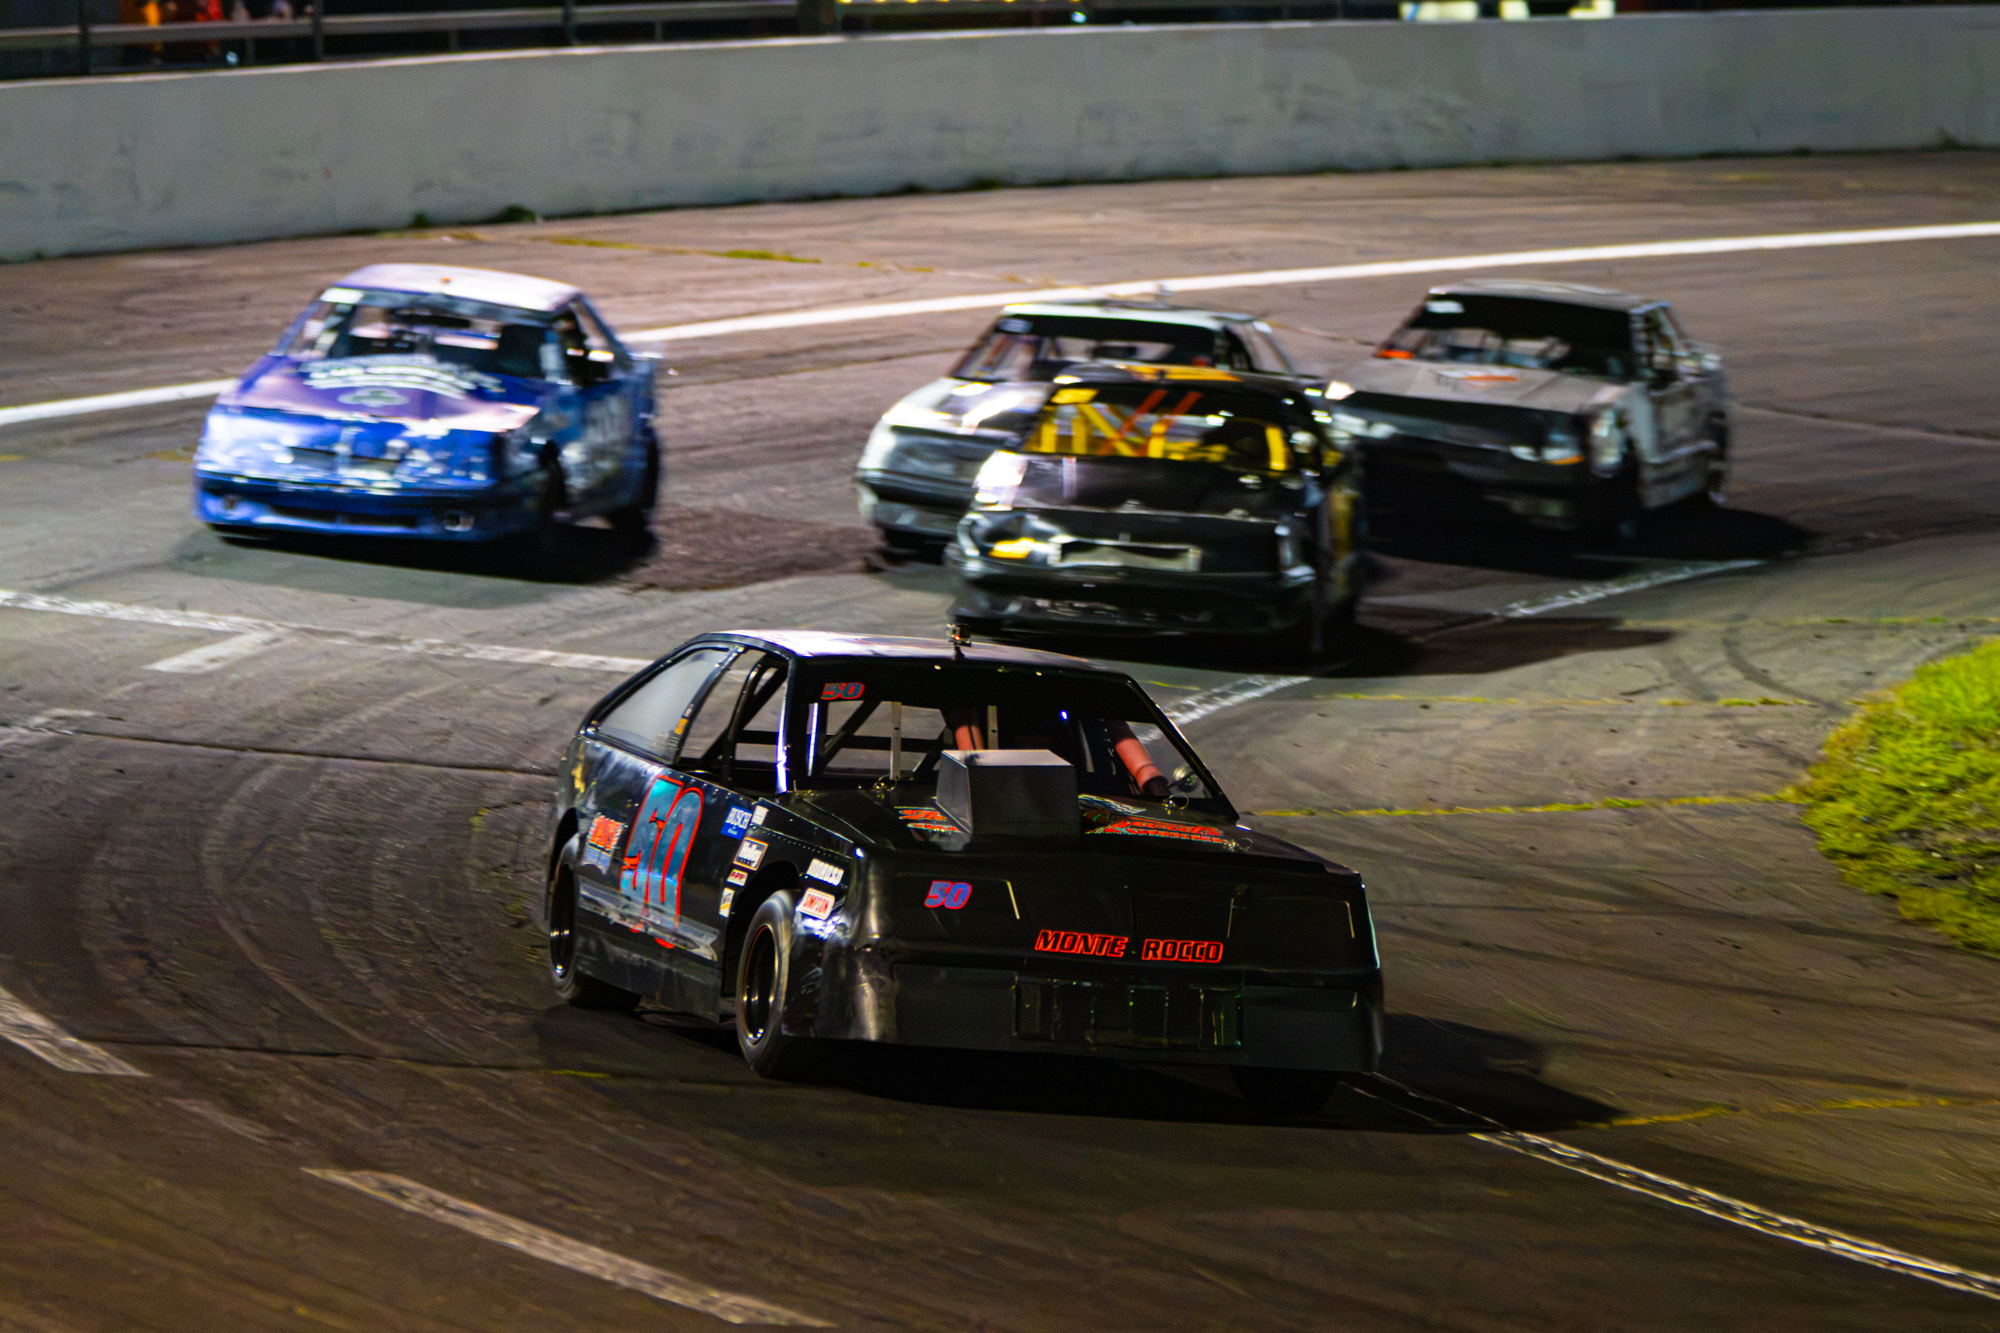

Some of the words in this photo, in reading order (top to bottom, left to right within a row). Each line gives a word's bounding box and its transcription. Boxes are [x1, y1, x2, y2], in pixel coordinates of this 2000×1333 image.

[820, 682, 865, 700] 50
[725, 807, 752, 829] BUSCH
[803, 892, 831, 914] SIMPSON
[924, 880, 972, 909] 50
[1034, 929, 1128, 957] MONTE
[1142, 939, 1223, 963] ROCCO
